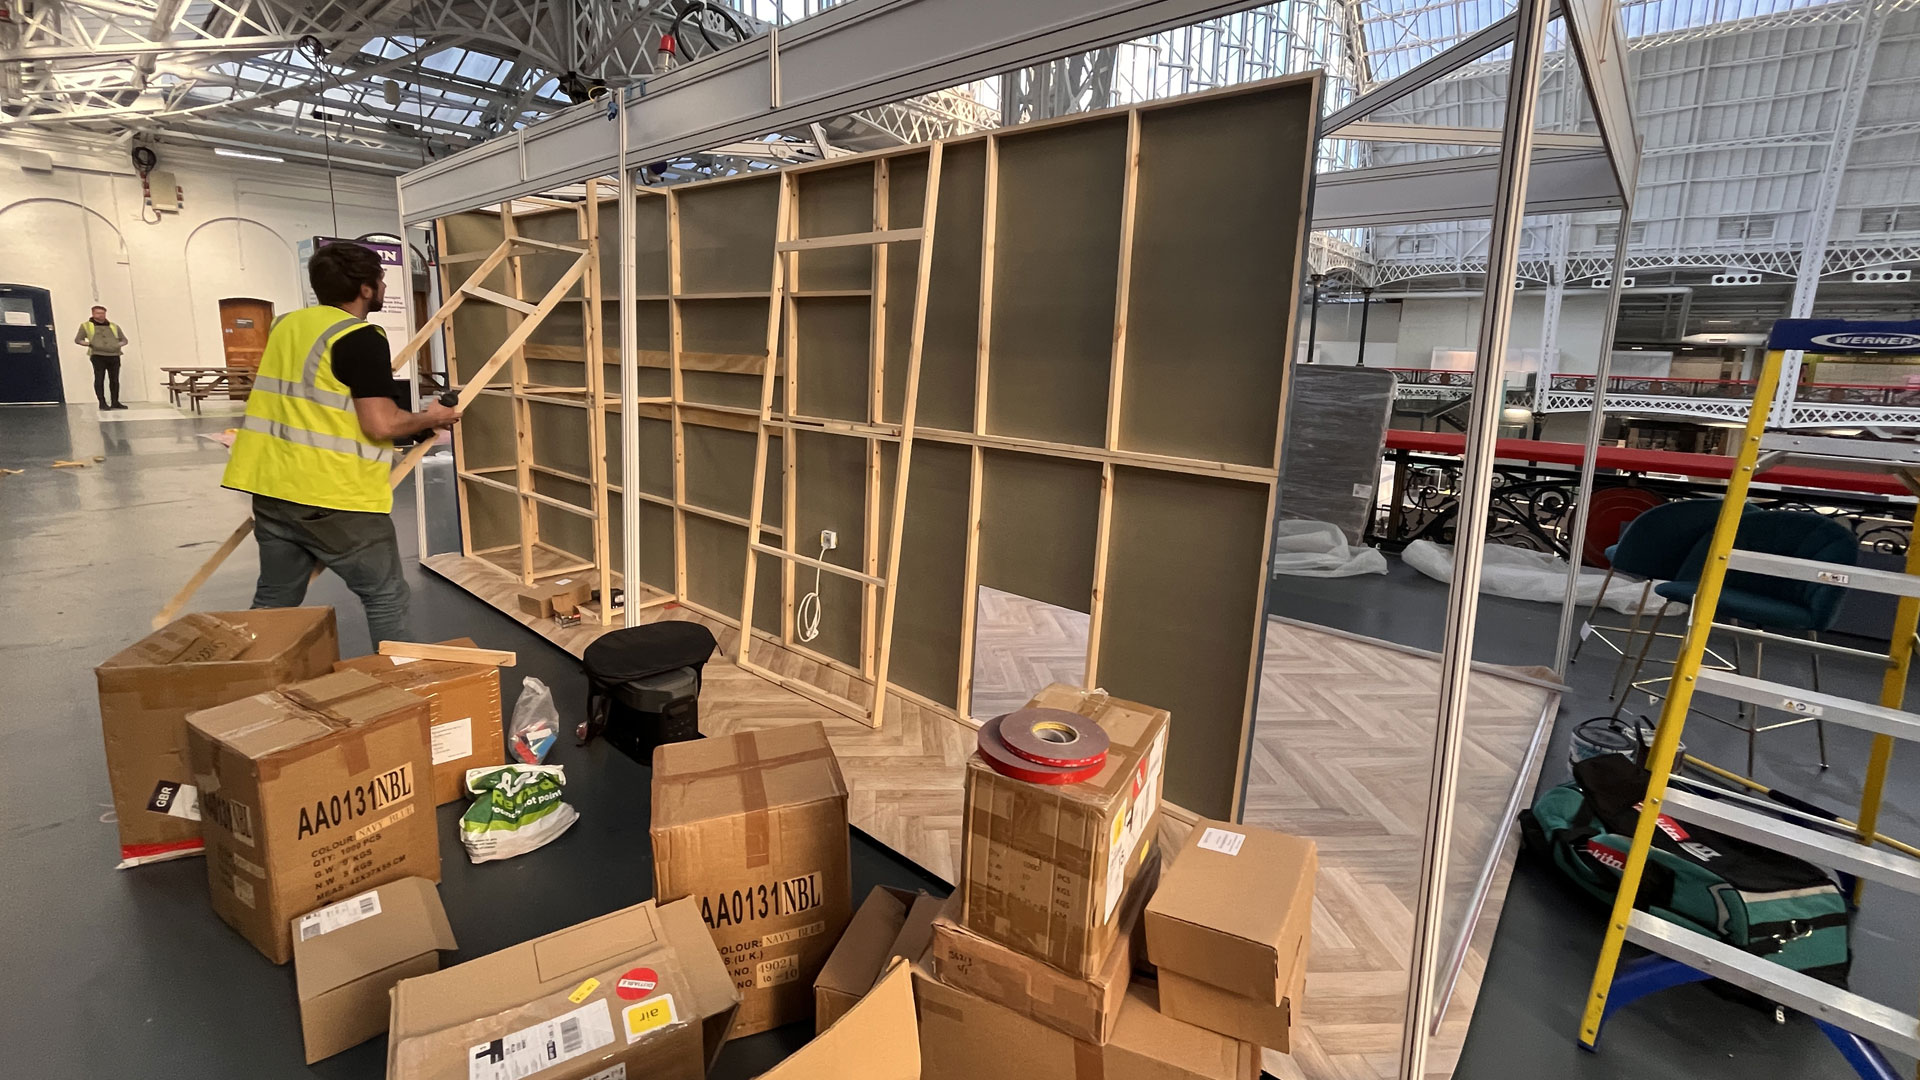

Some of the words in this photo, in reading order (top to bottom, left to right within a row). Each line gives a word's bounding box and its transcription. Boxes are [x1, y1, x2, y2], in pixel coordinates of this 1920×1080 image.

[1835, 336, 1914, 345] WERNER
[156, 786, 174, 807] GBR
[359, 821, 384, 837] NAVY
[363, 833, 382, 847] PCS
[353, 848, 373, 862] KGS
[718, 940, 763, 955] OLOUR:
[765, 931, 791, 945] NAVY
[639, 1008, 659, 1022] air
